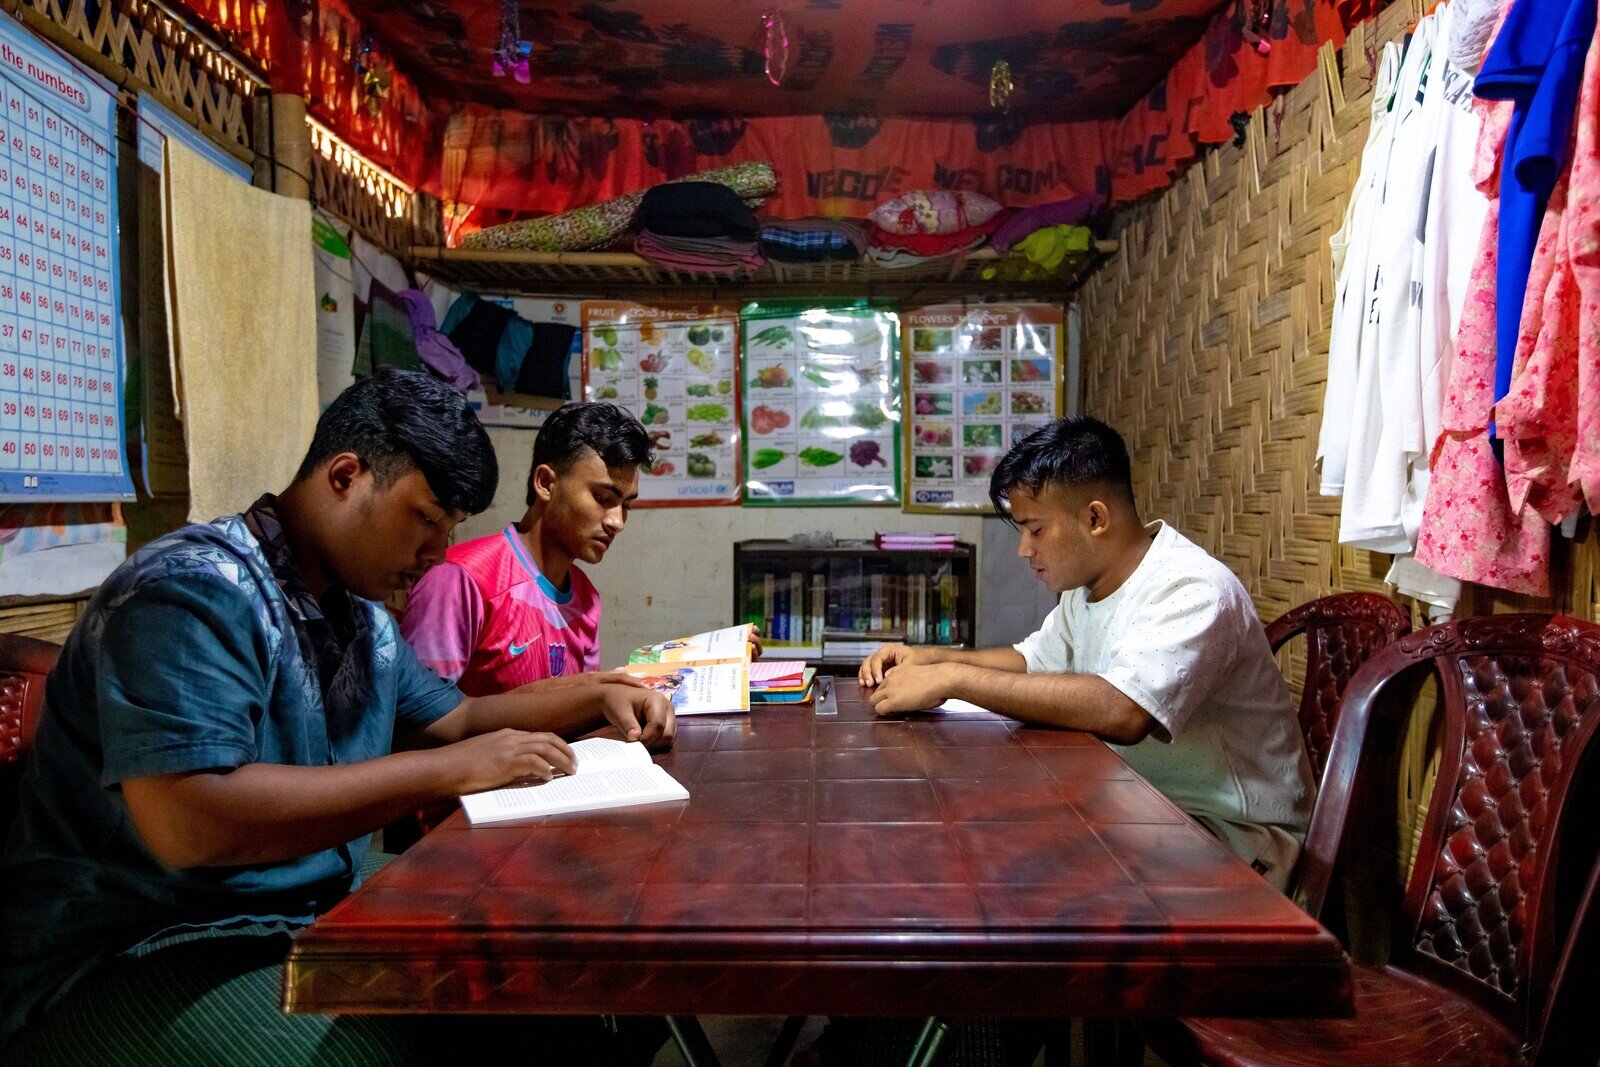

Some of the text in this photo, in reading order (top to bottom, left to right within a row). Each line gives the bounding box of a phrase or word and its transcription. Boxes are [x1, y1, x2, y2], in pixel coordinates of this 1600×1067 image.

[2, 44, 85, 104] the numbers
[10, 98, 21, 112] 41
[28, 109, 38, 122] 51
[47, 118, 57, 131] 61
[64, 127, 74, 140] 71
[81, 135, 89, 148] 81
[13, 138, 23, 151] 42
[31, 146, 41, 160] 52
[49, 155, 59, 168] 62
[65, 162, 75, 175] 72
[82, 171, 90, 183] 82
[96, 178, 104, 190] 92
[15, 176, 26, 189] 43
[32, 184, 42, 197] 53
[50, 192, 60, 204] 63
[67, 199, 76, 211] 73
[82, 206, 90, 218] 83
[96, 212, 104, 224] 93
[17, 215, 28, 228] 44
[35, 222, 44, 234] 54
[51, 228, 61, 241] 64
[67, 235, 76, 247] 74
[82, 241, 91, 252] 84
[96, 247, 105, 258] 94
[0, 246, 108, 292] 35 45 55 65 75 85 95
[2, 286, 110, 326] 36 46 56 66 76 86 96
[588, 308, 615, 316] FRUIT
[909, 315, 954, 324] FLOWERS
[3, 325, 111, 359] 37 47 57 67 77 87 97
[4, 364, 112, 393] 38 48 58 68 78 88 98
[4, 403, 113, 426] 39 49 59 69 79 89 99
[3, 442, 117, 459] 40 50 60 70 80 90 100
[677, 482, 714, 494] unicef
